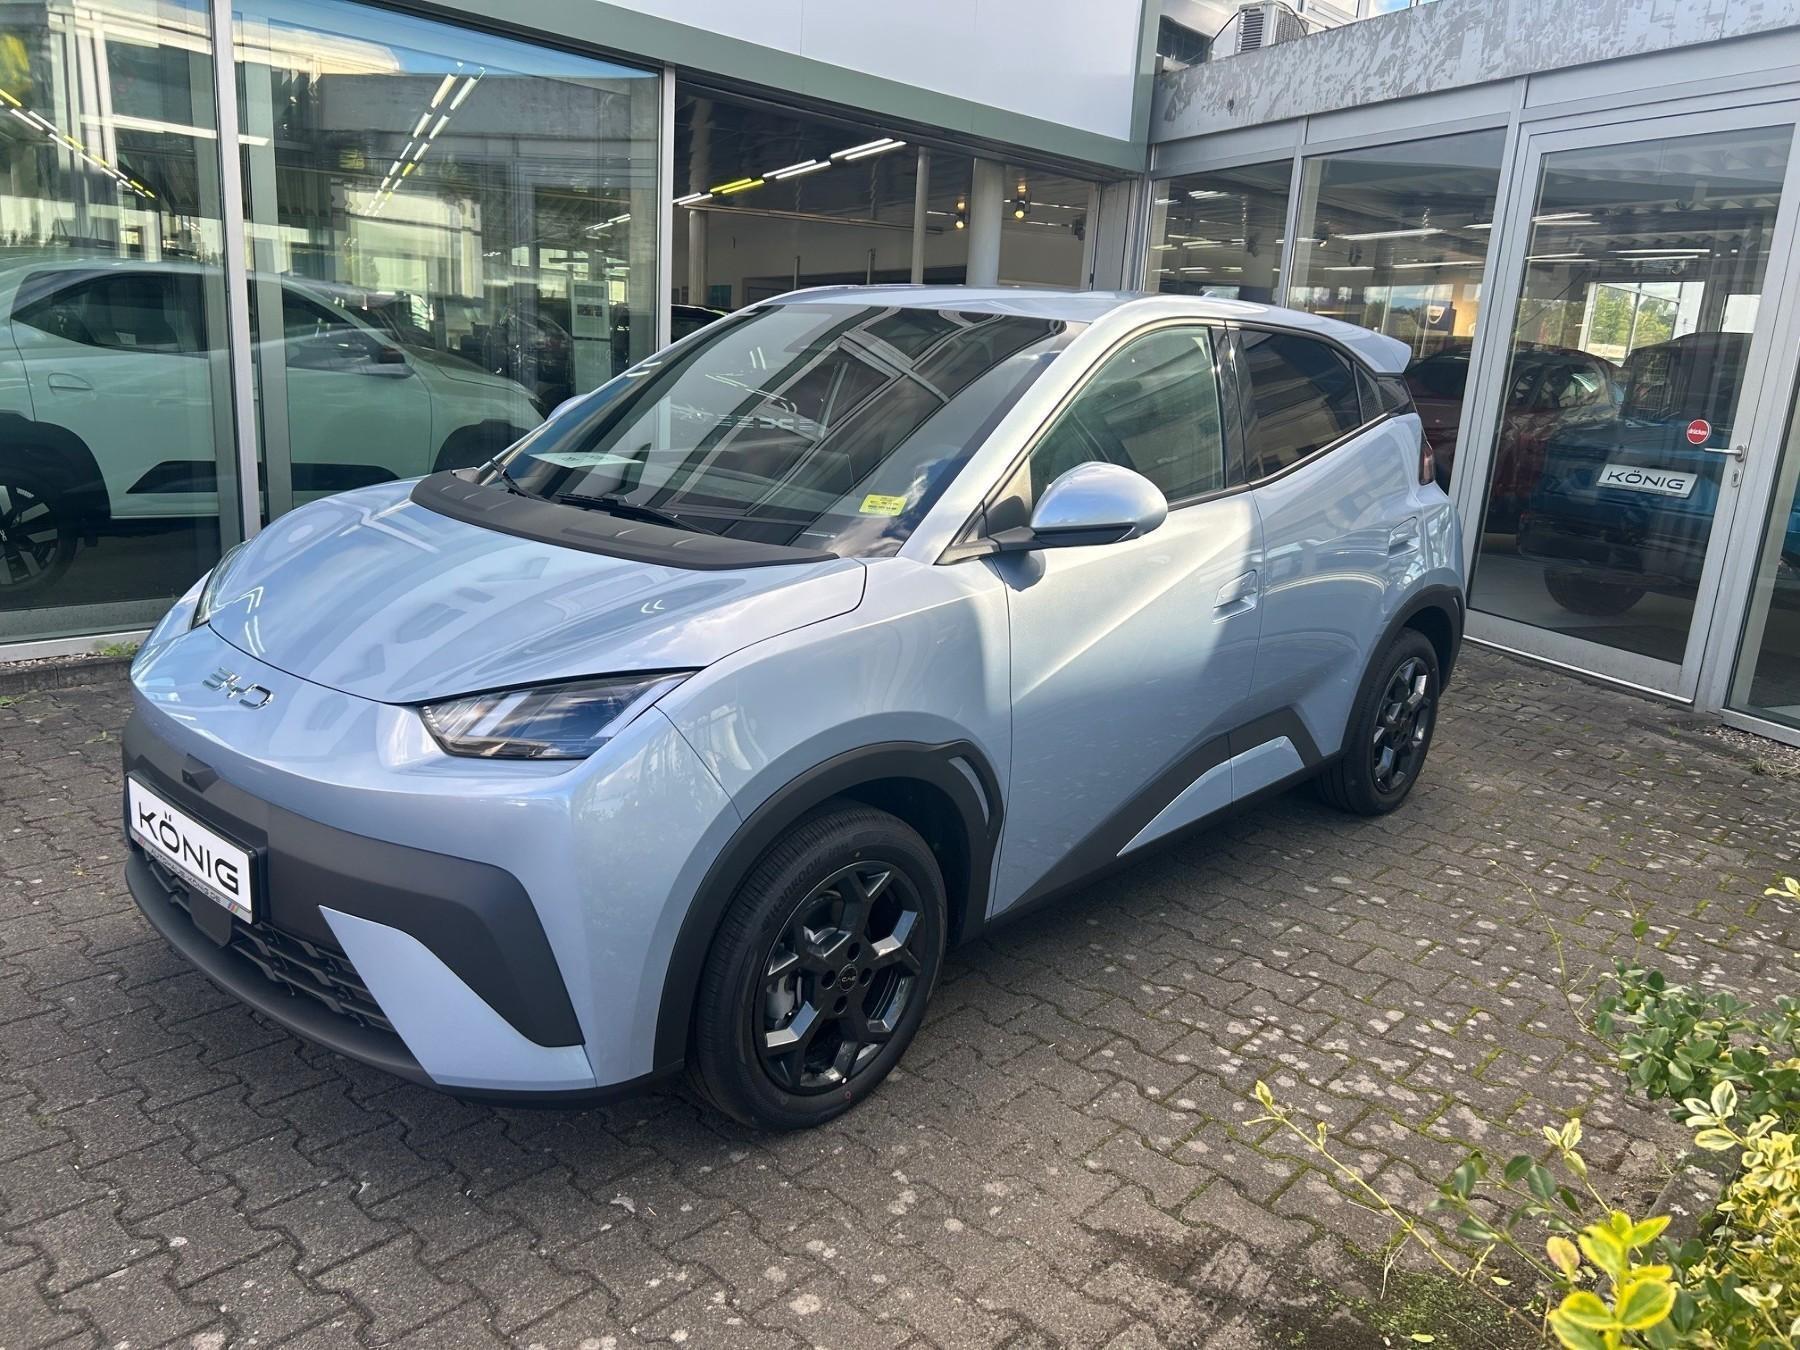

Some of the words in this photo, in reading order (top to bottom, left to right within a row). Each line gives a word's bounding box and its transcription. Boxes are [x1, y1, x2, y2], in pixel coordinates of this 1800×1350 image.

[1607, 470, 1685, 490] KÖNIG
[202, 667, 274, 710] BYD
[138, 801, 239, 896] KÖNIG
